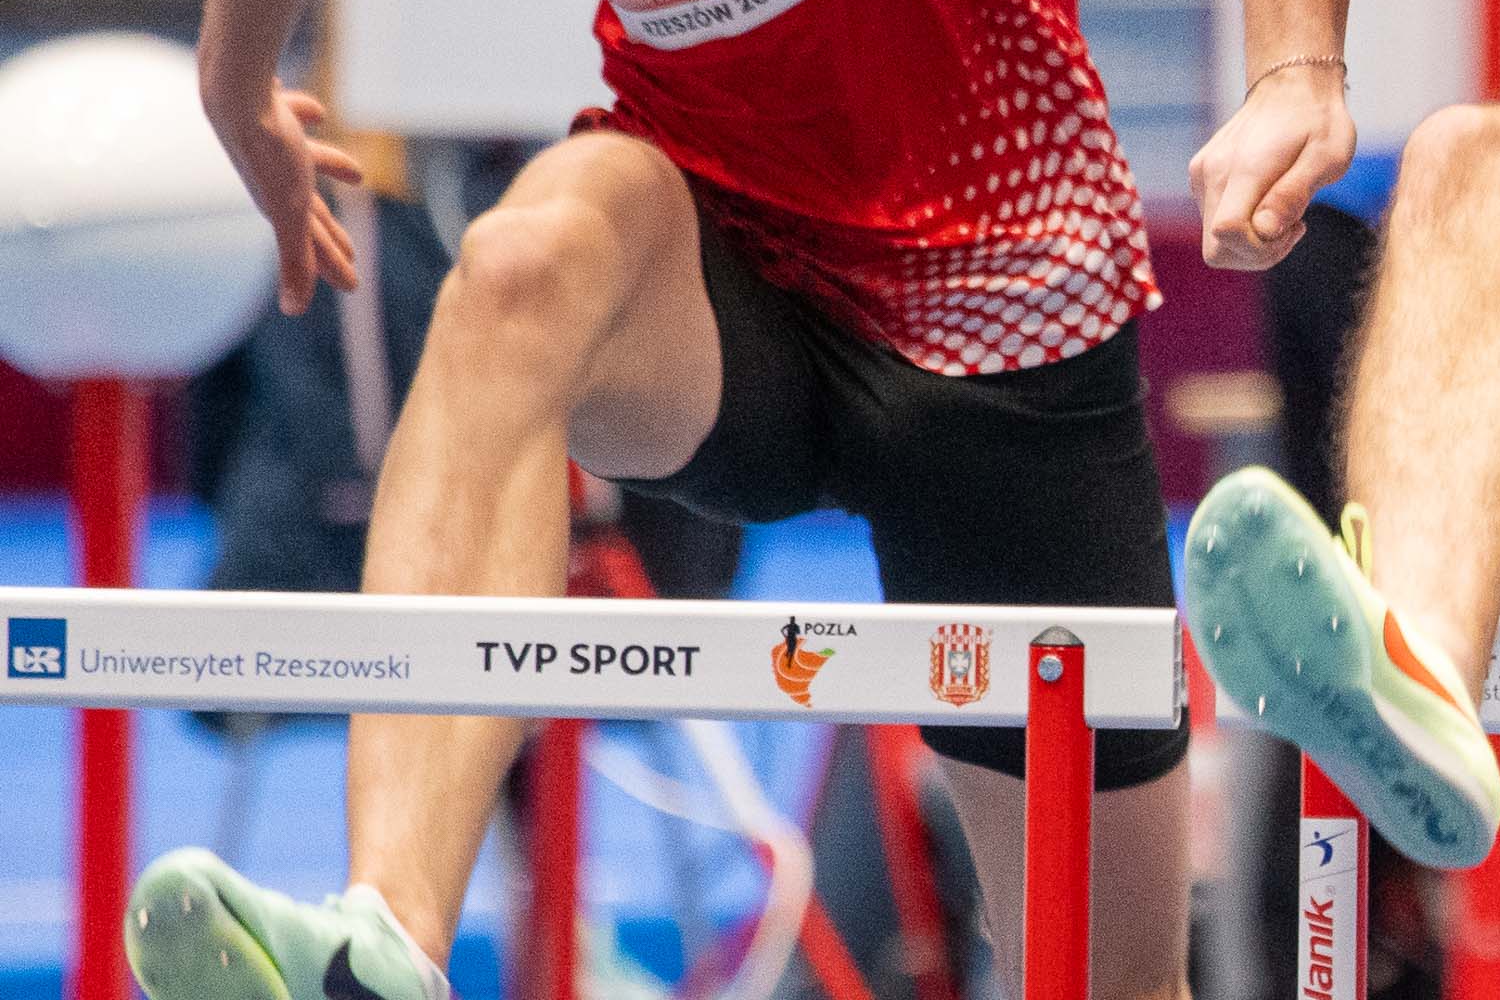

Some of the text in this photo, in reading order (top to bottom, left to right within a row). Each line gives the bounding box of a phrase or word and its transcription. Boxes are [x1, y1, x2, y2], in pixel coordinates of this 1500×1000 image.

[804, 622, 858, 638] POZLA
[81, 648, 411, 682] Uniwersytet Rzeszowski
[477, 641, 700, 677] TVP SPORT
